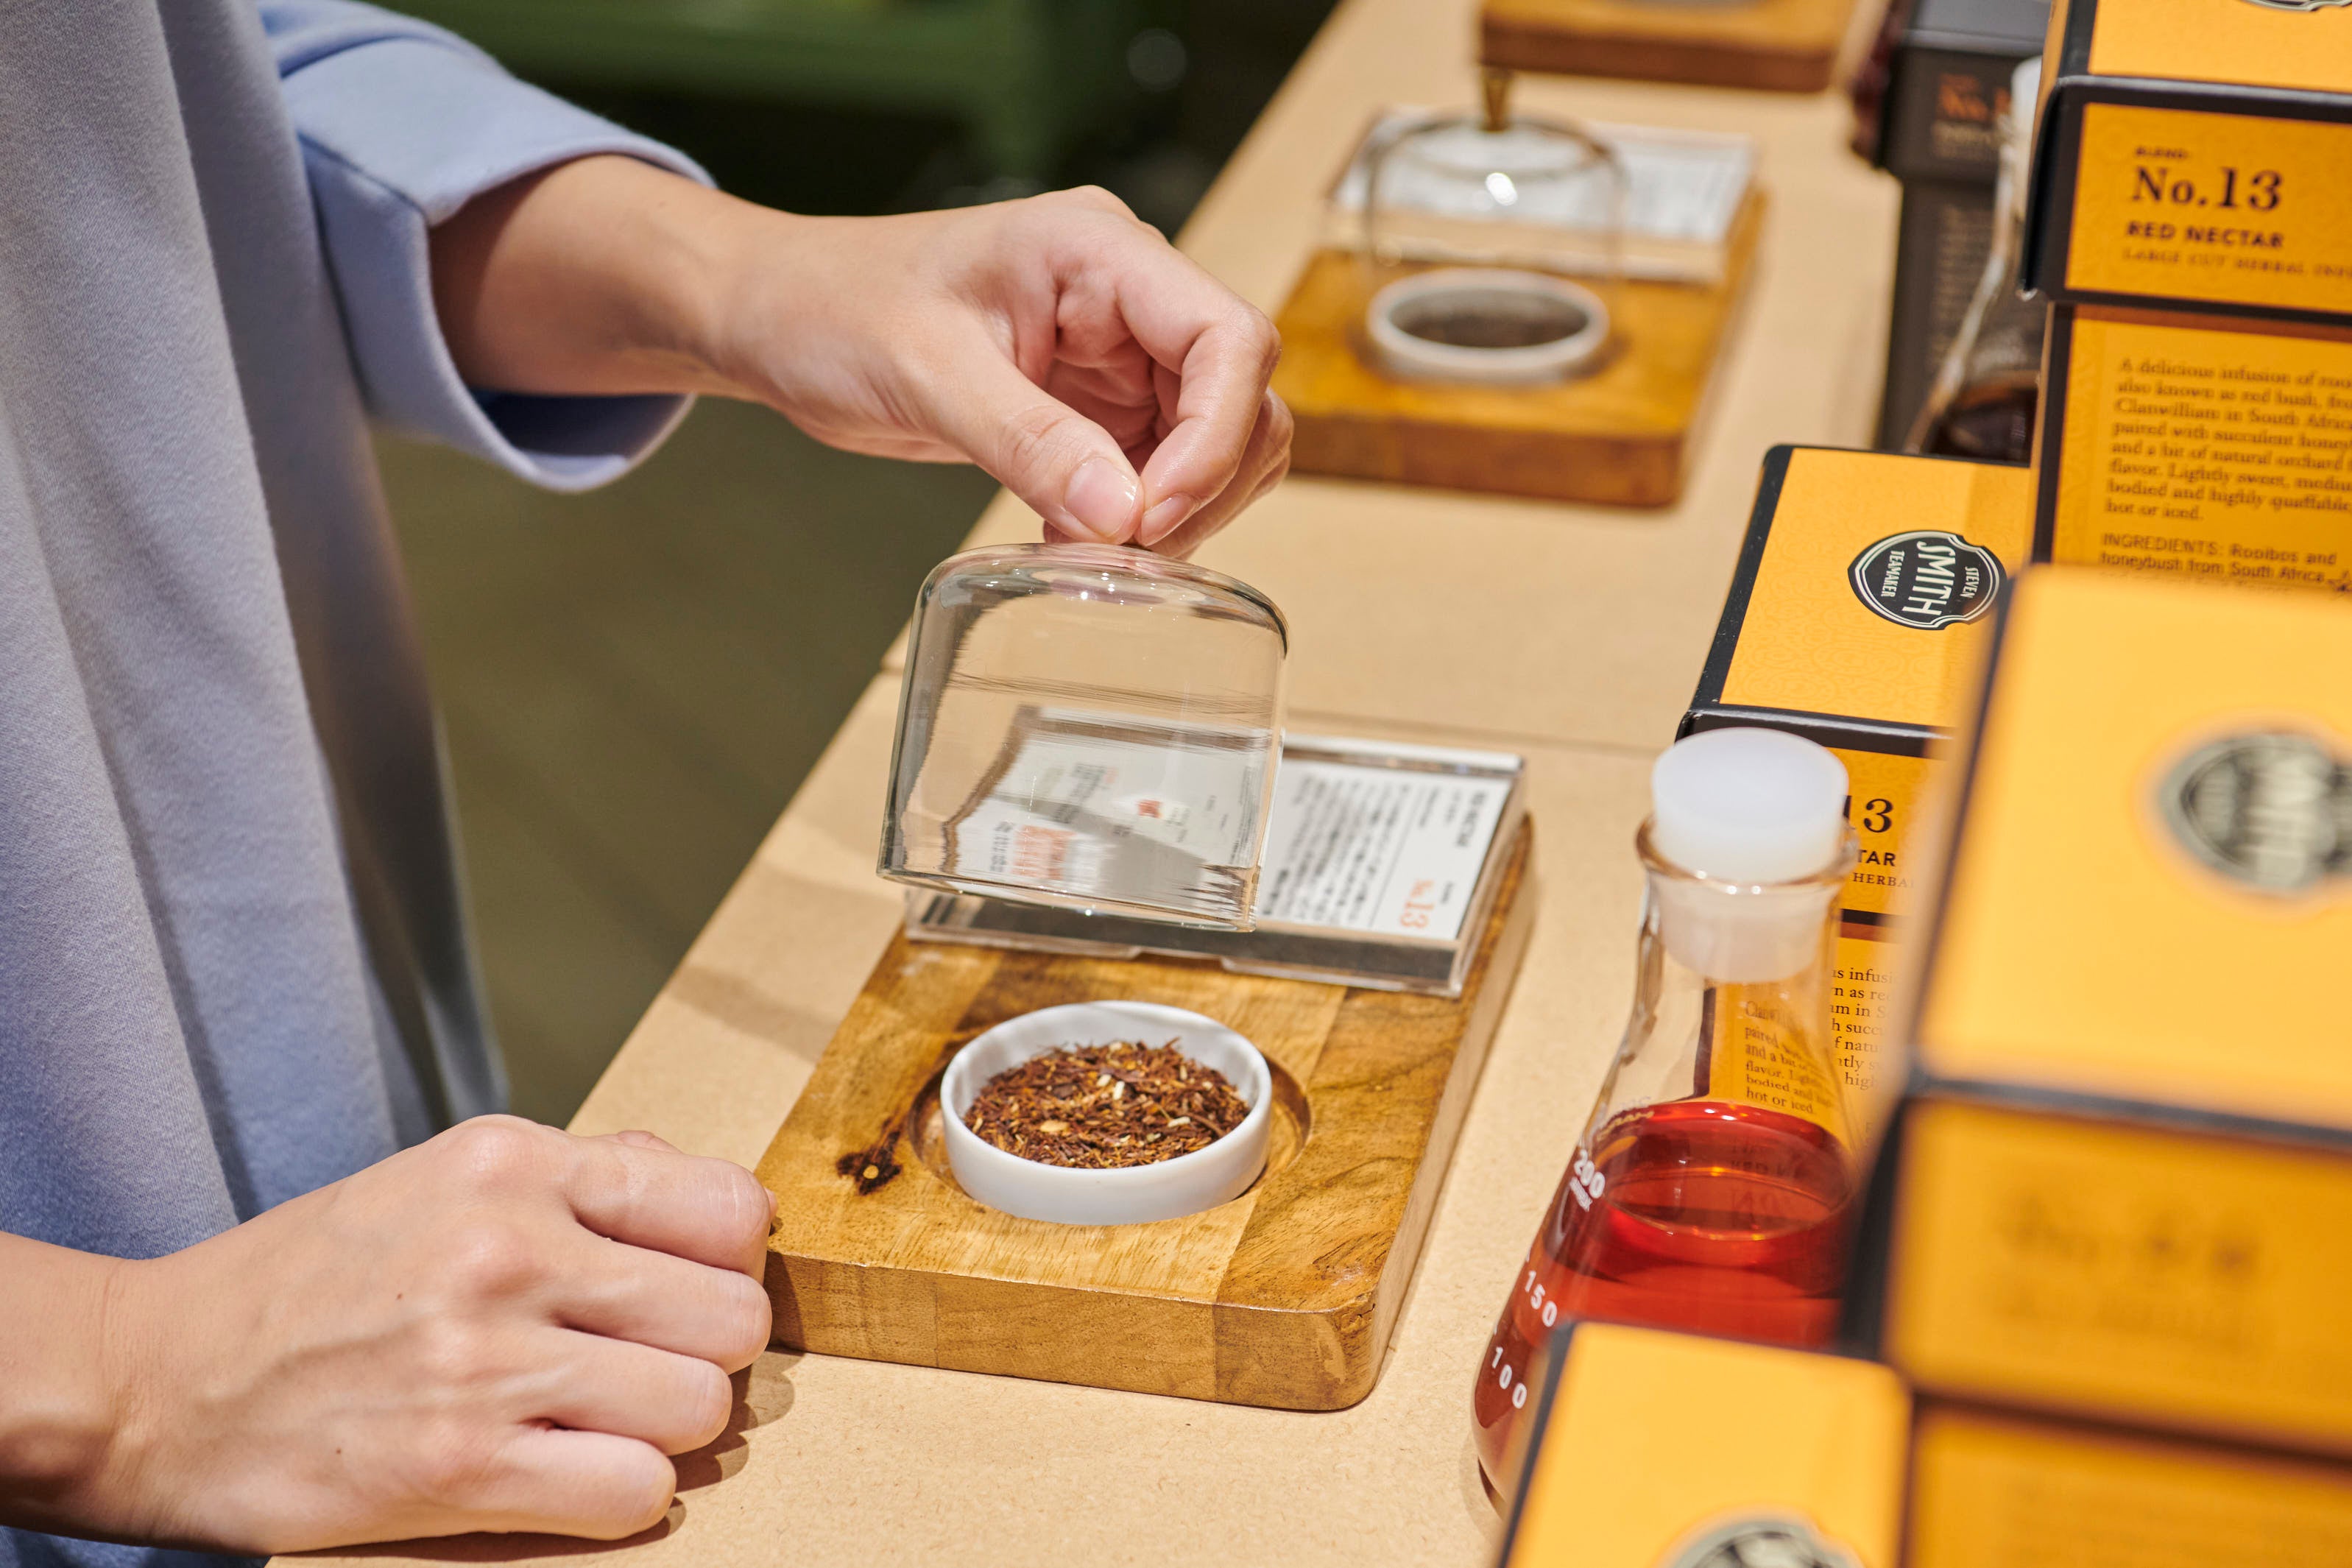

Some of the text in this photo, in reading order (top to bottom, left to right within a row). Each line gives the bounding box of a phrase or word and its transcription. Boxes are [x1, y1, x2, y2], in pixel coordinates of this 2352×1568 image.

[2132, 166, 2283, 211] No.13
[2127, 221, 2283, 248] RED NECTAR
[2140, 359, 2214, 376] delicious
[2222, 366, 2290, 383] infusion
[2296, 370, 2315, 384] of
[2117, 378, 2150, 392] also
[2155, 381, 2214, 398] known
[2242, 388, 2270, 402] red
[2114, 398, 2220, 419] Clanwilliam
[2225, 409, 2242, 420] in
[2250, 408, 2299, 425] South
[2112, 421, 2167, 437] paired
[2173, 424, 2207, 439] with
[2215, 429, 2293, 445] succulent
[2111, 440, 2142, 454] and
[2189, 445, 2210, 459] of
[2211, 450, 2272, 464] natural
[2278, 452, 2344, 470] orchard
[2169, 463, 2231, 486] Lightly
[2107, 498, 2133, 512] hot
[2108, 478, 2167, 497] bodied
[2174, 486, 2205, 500] and
[2210, 487, 2264, 510] highly
[2103, 533, 2337, 565] INGREDIENTS: Rooibos and
[1881, 550, 1905, 597] TEAMAKER
[1901, 540, 1956, 615] SMITH
[2101, 552, 2183, 571] honeybush
[2188, 559, 2224, 573] from
[2231, 562, 2275, 578] South
[1960, 565, 1980, 598] STEVEN
[1849, 989, 1865, 999] as
[1855, 1003, 1871, 1017] in
[1747, 1074, 1790, 1092] bodied
[1747, 1087, 1767, 1103] hot
[1773, 1096, 1786, 1107] or
[1574, 1149, 1606, 1198] 200
[1525, 1271, 1557, 1327] 150
[1491, 1346, 1527, 1409] 100
